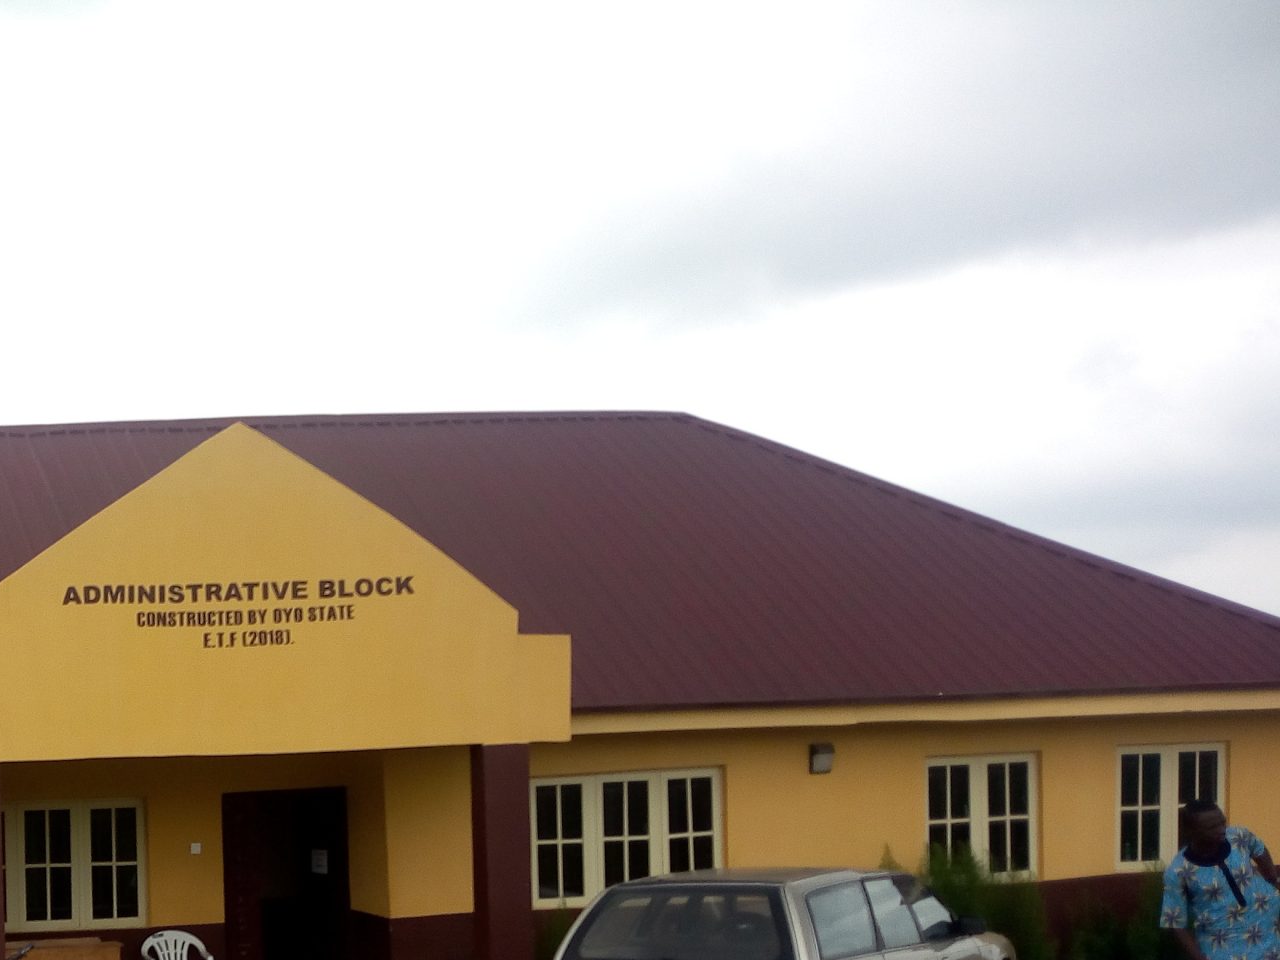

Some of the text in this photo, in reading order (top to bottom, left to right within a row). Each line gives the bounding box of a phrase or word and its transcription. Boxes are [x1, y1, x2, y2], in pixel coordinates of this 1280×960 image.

[62, 576, 415, 606] ADMINISTRATIVE BLOCK
[136, 604, 355, 628] CONSTRUCTED BY OYO STATE
